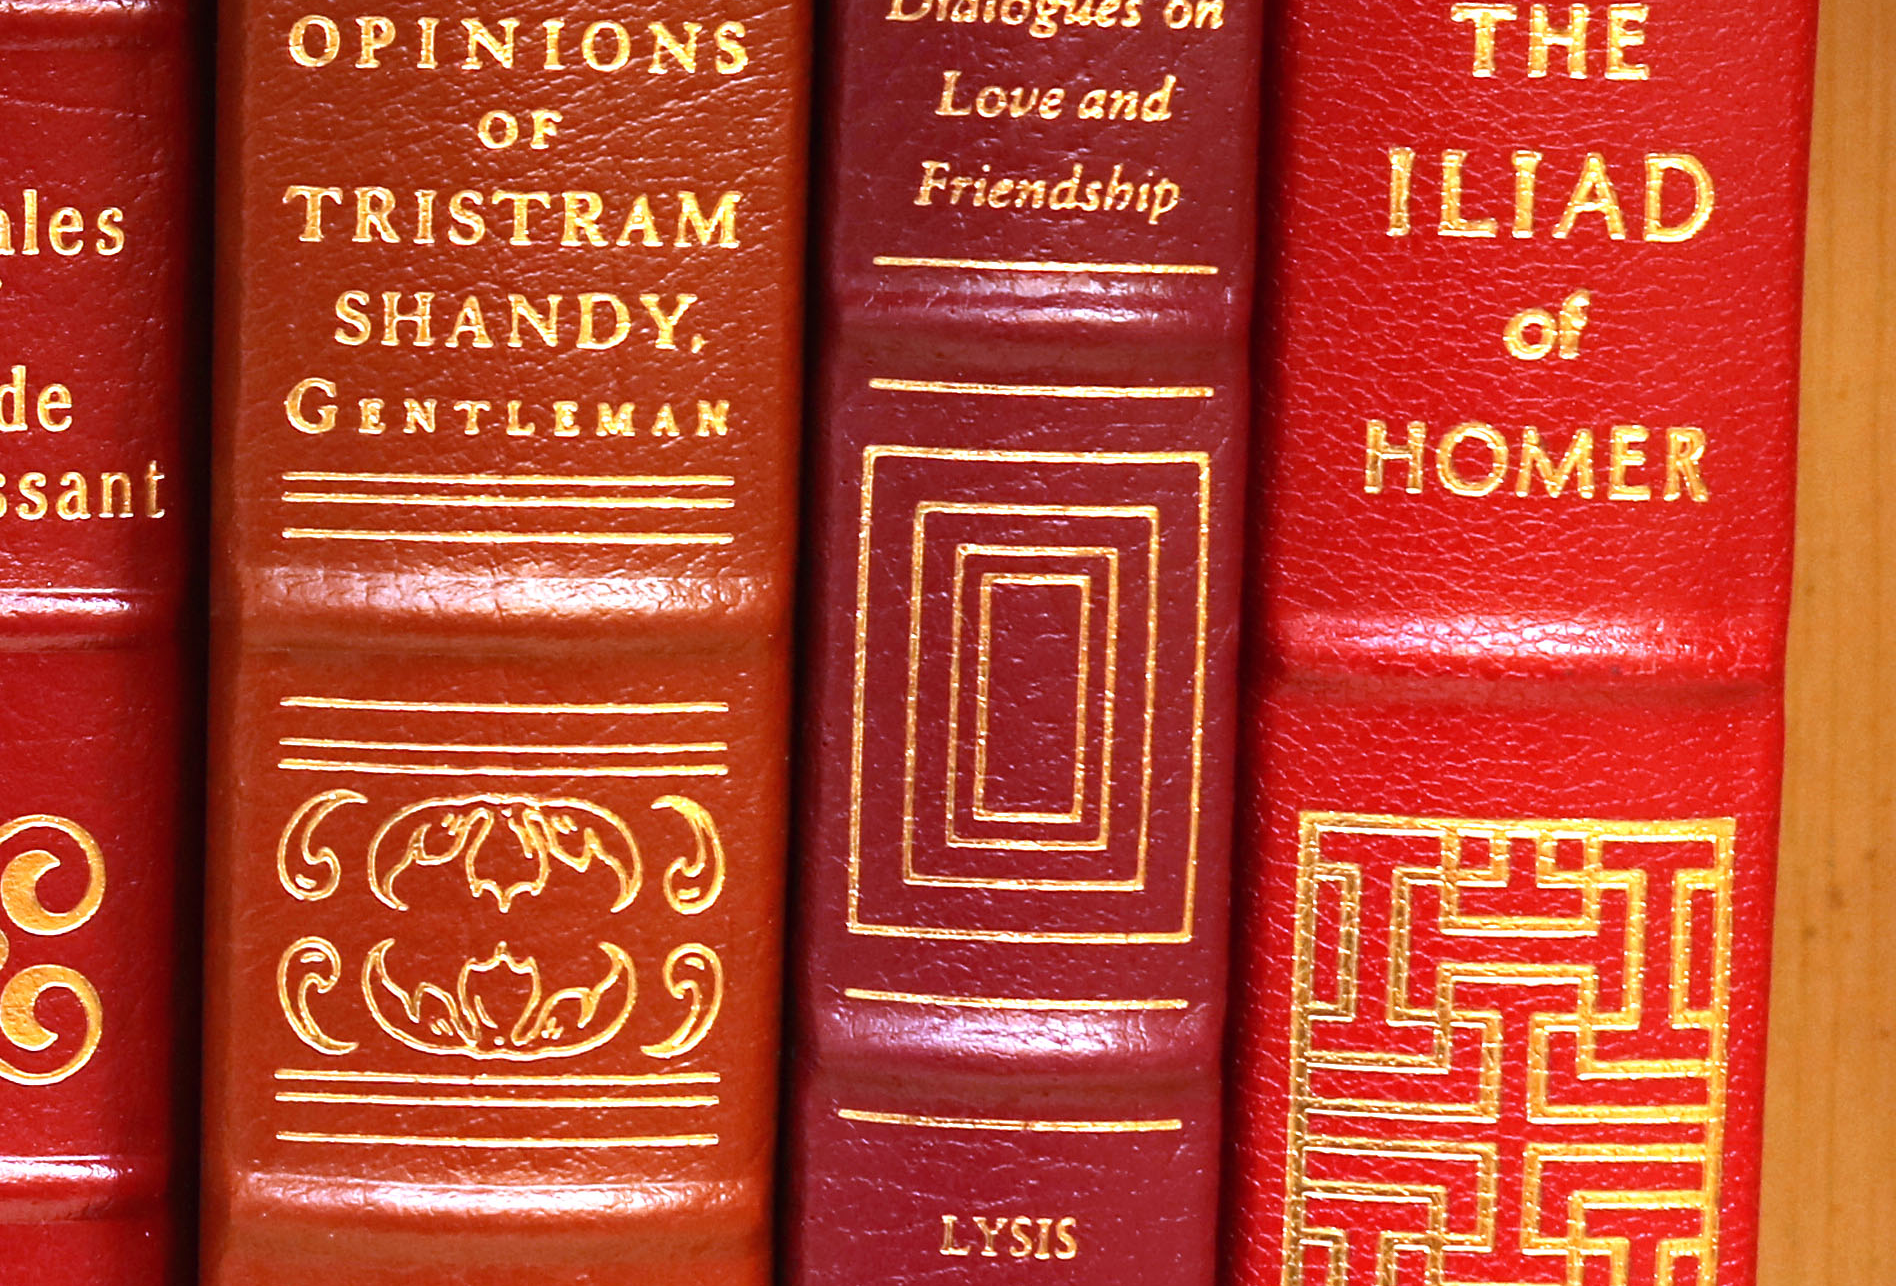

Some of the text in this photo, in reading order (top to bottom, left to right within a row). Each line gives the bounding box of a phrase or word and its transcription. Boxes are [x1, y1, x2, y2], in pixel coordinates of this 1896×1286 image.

[287, 15, 751, 76] OPINIONS
[1450, 1, 1650, 81] THE
[935, 70, 1177, 123] Love and
[477, 109, 564, 150] OF
[282, 185, 744, 250] TRISTRAM
[913, 160, 1181, 225] Friendship
[1385, 146, 1715, 242] ILIAD
[334, 290, 708, 354] SHANDY,
[1503, 288, 1591, 360] of
[1362, 418, 1709, 503] HOMER
[939, 1214, 1078, 1260] LYSIS
